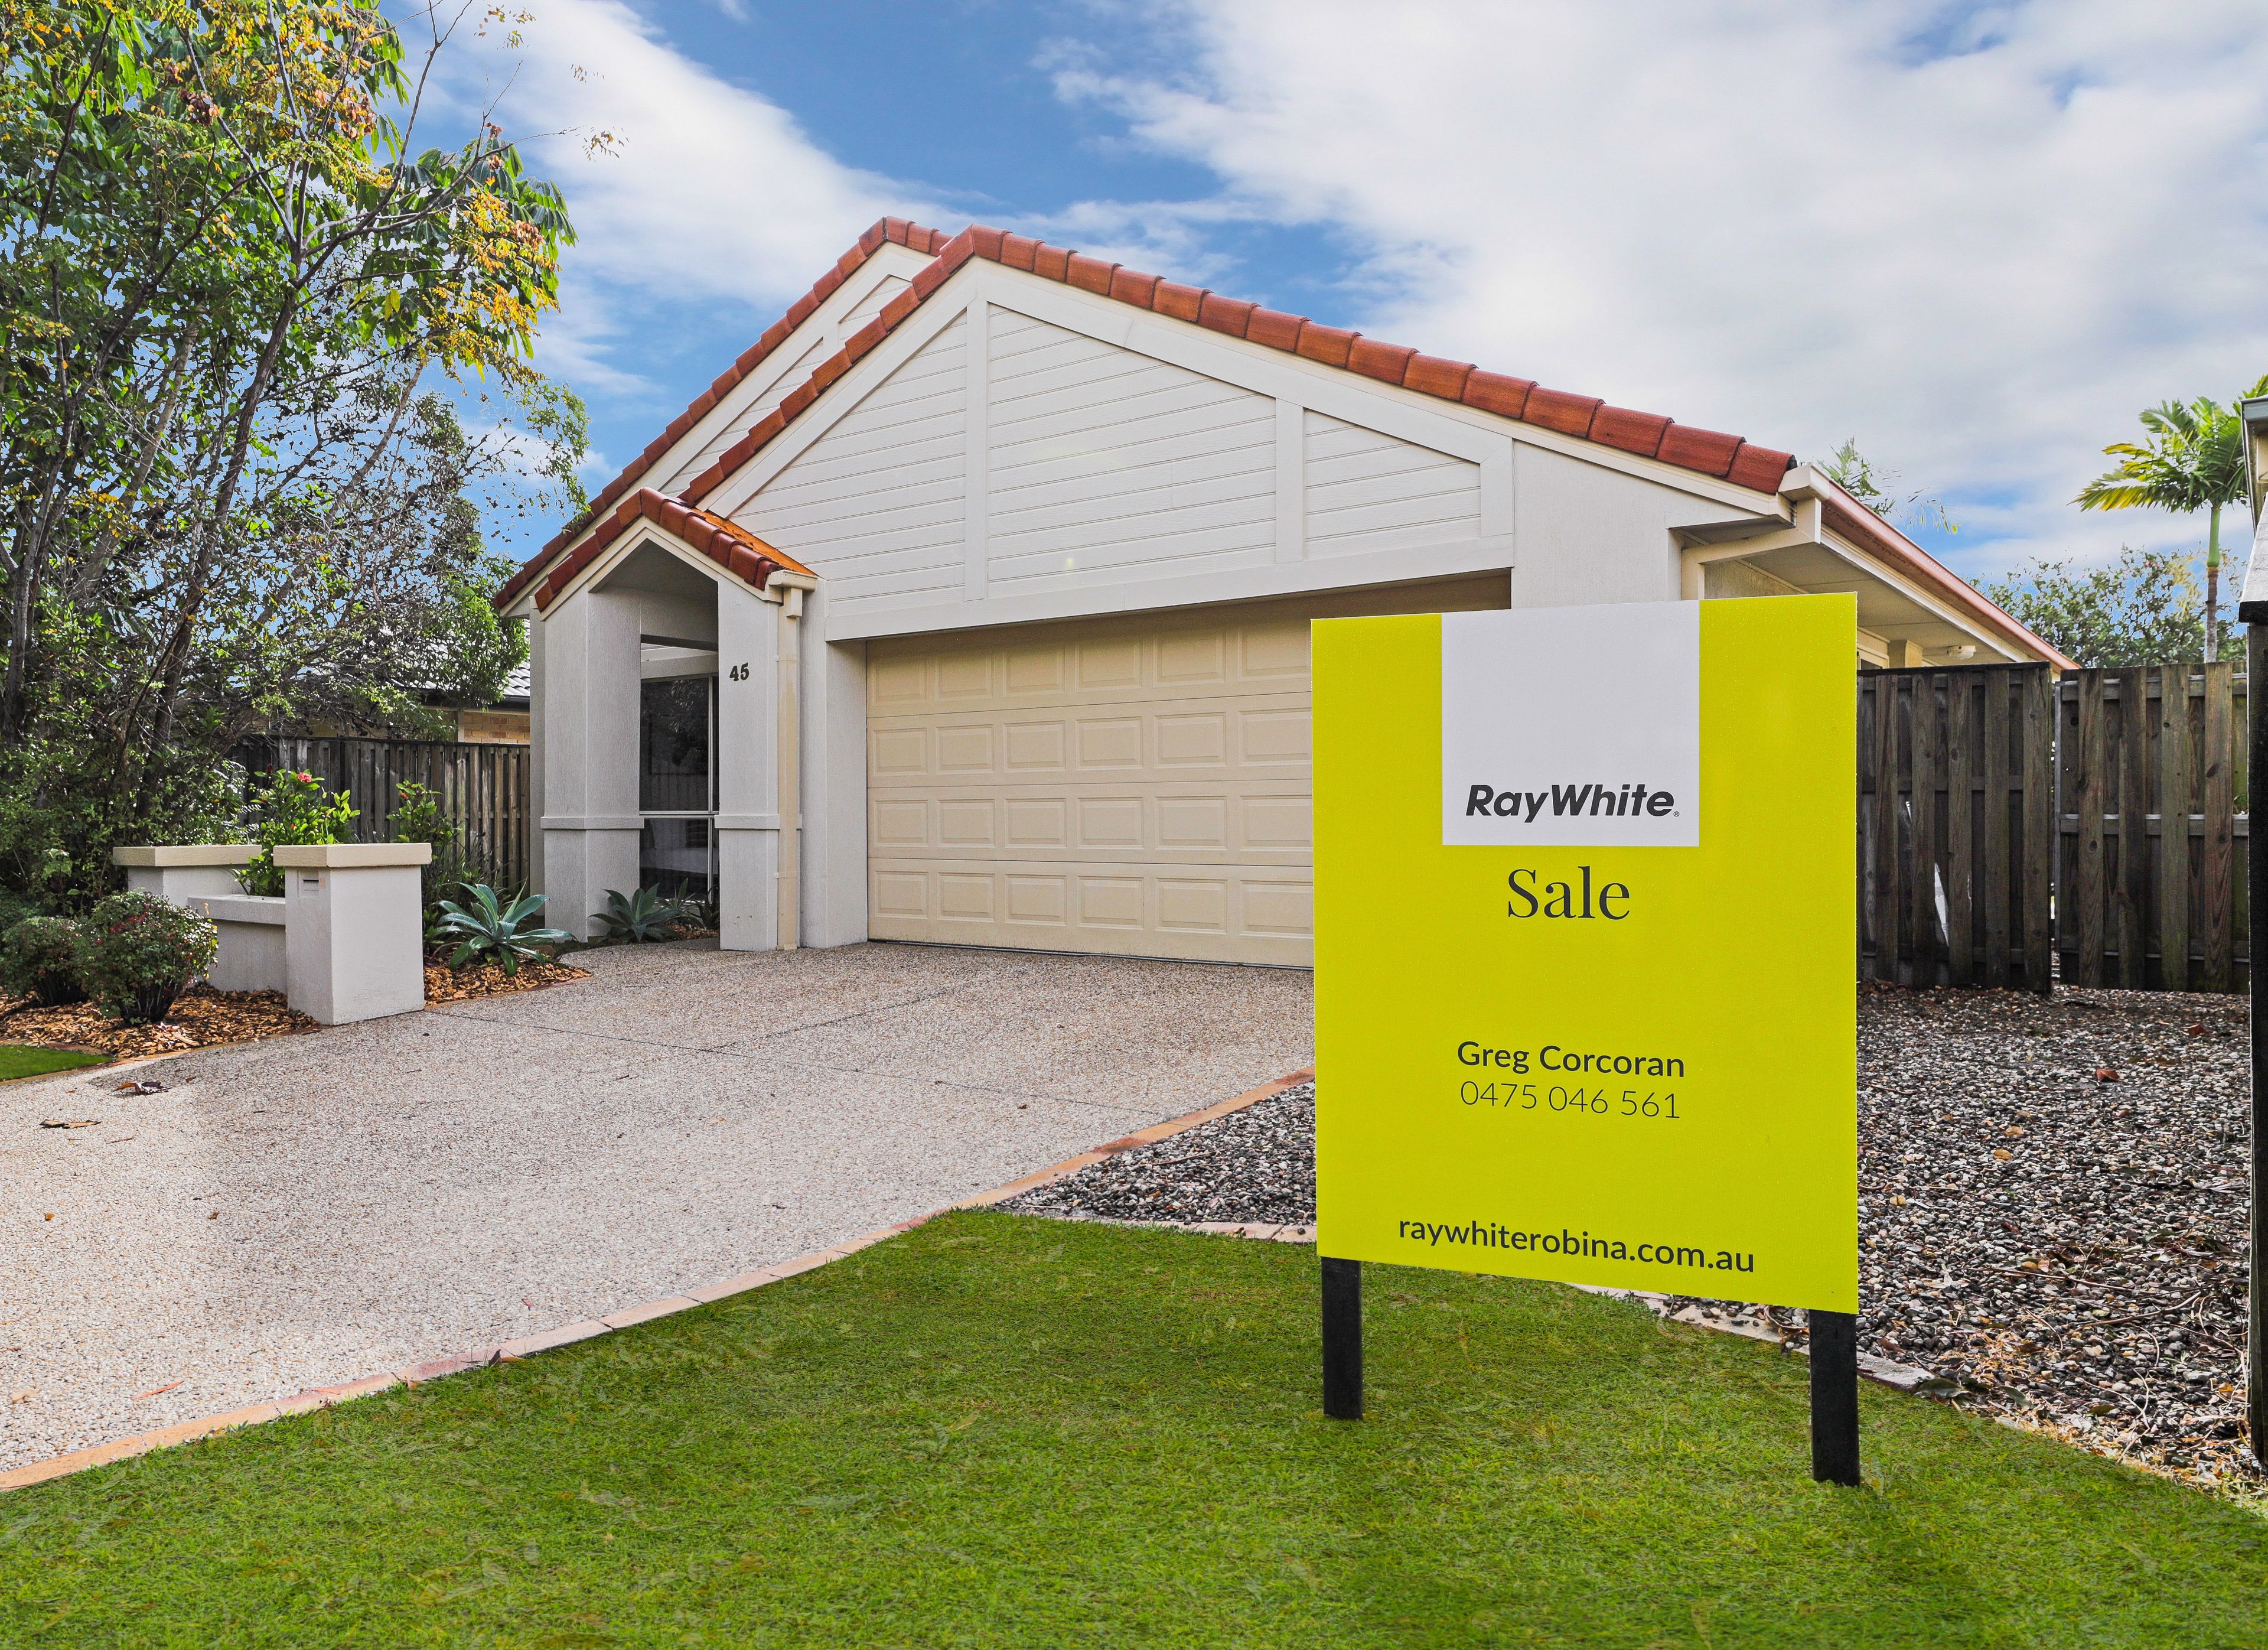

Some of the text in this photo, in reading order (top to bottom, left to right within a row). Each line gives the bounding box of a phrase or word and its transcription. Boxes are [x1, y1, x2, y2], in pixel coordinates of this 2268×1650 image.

[729, 662, 750, 682] 45
[1508, 865, 1630, 920] Sale
[1457, 1041, 1684, 1078] Greg Corcoran
[1460, 1081, 1681, 1119] 0475 046 561
[1399, 1220, 1754, 1273] raywhiterobina.com.au
